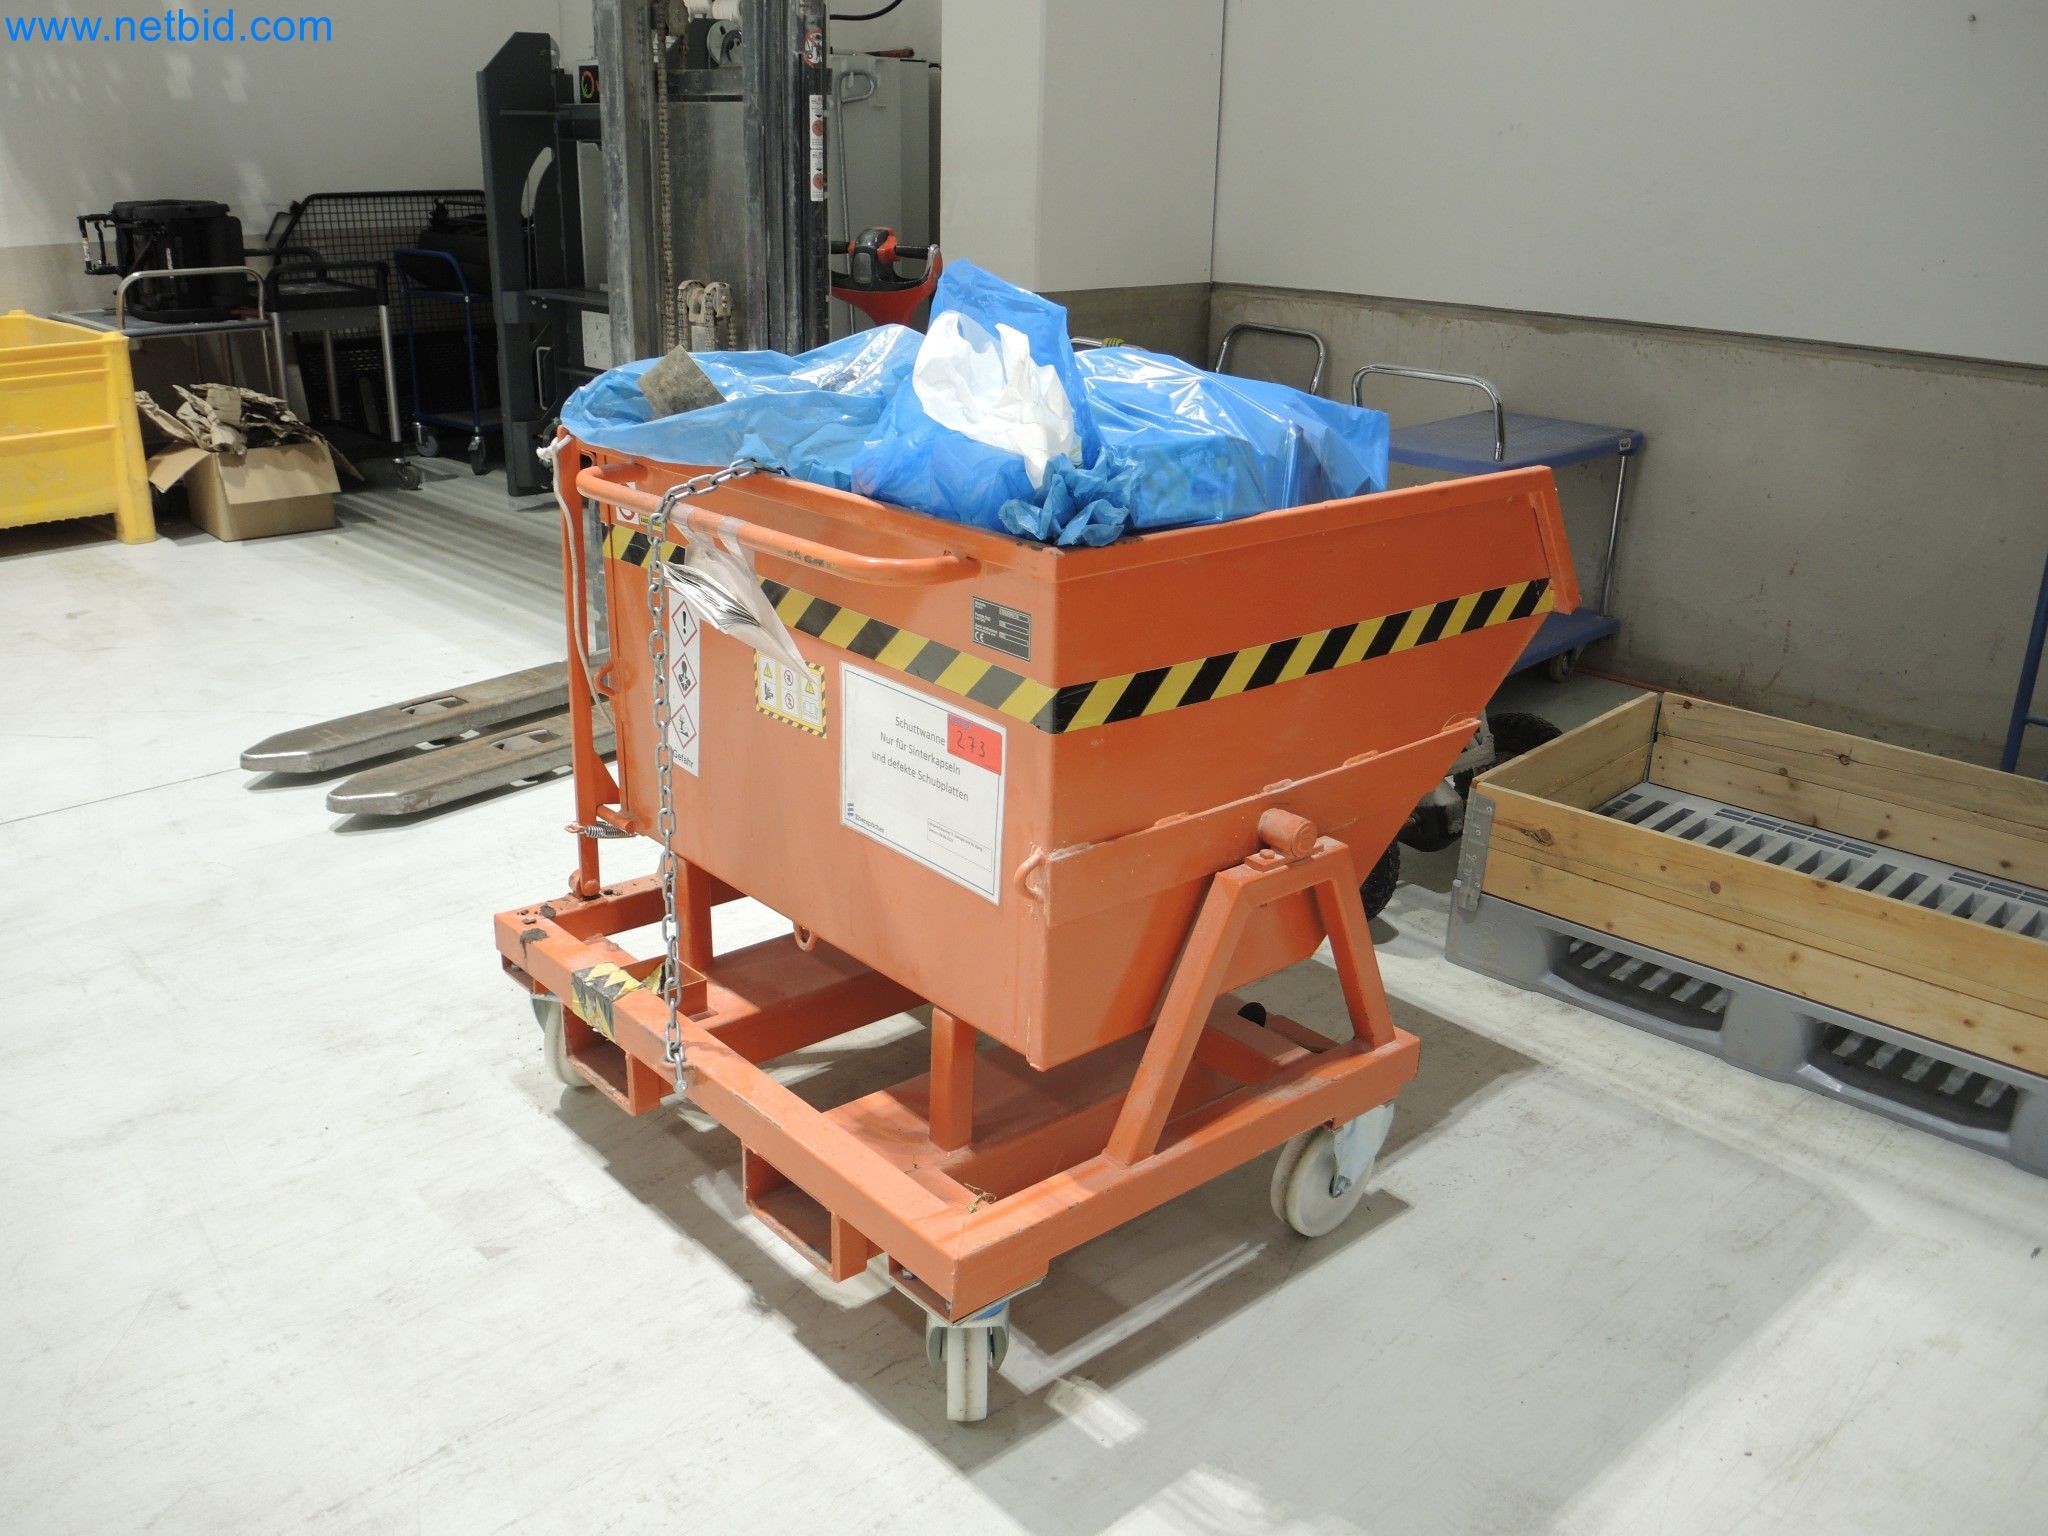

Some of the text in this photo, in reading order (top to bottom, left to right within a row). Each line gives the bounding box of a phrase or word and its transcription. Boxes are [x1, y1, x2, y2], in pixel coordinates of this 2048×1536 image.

[895, 716, 946, 746] Schuttwanne
[957, 730, 986, 758] 273
[880, 732, 961, 775] Nur für Sinterkapseln
[872, 751, 969, 801] und defekte Schubplatten
